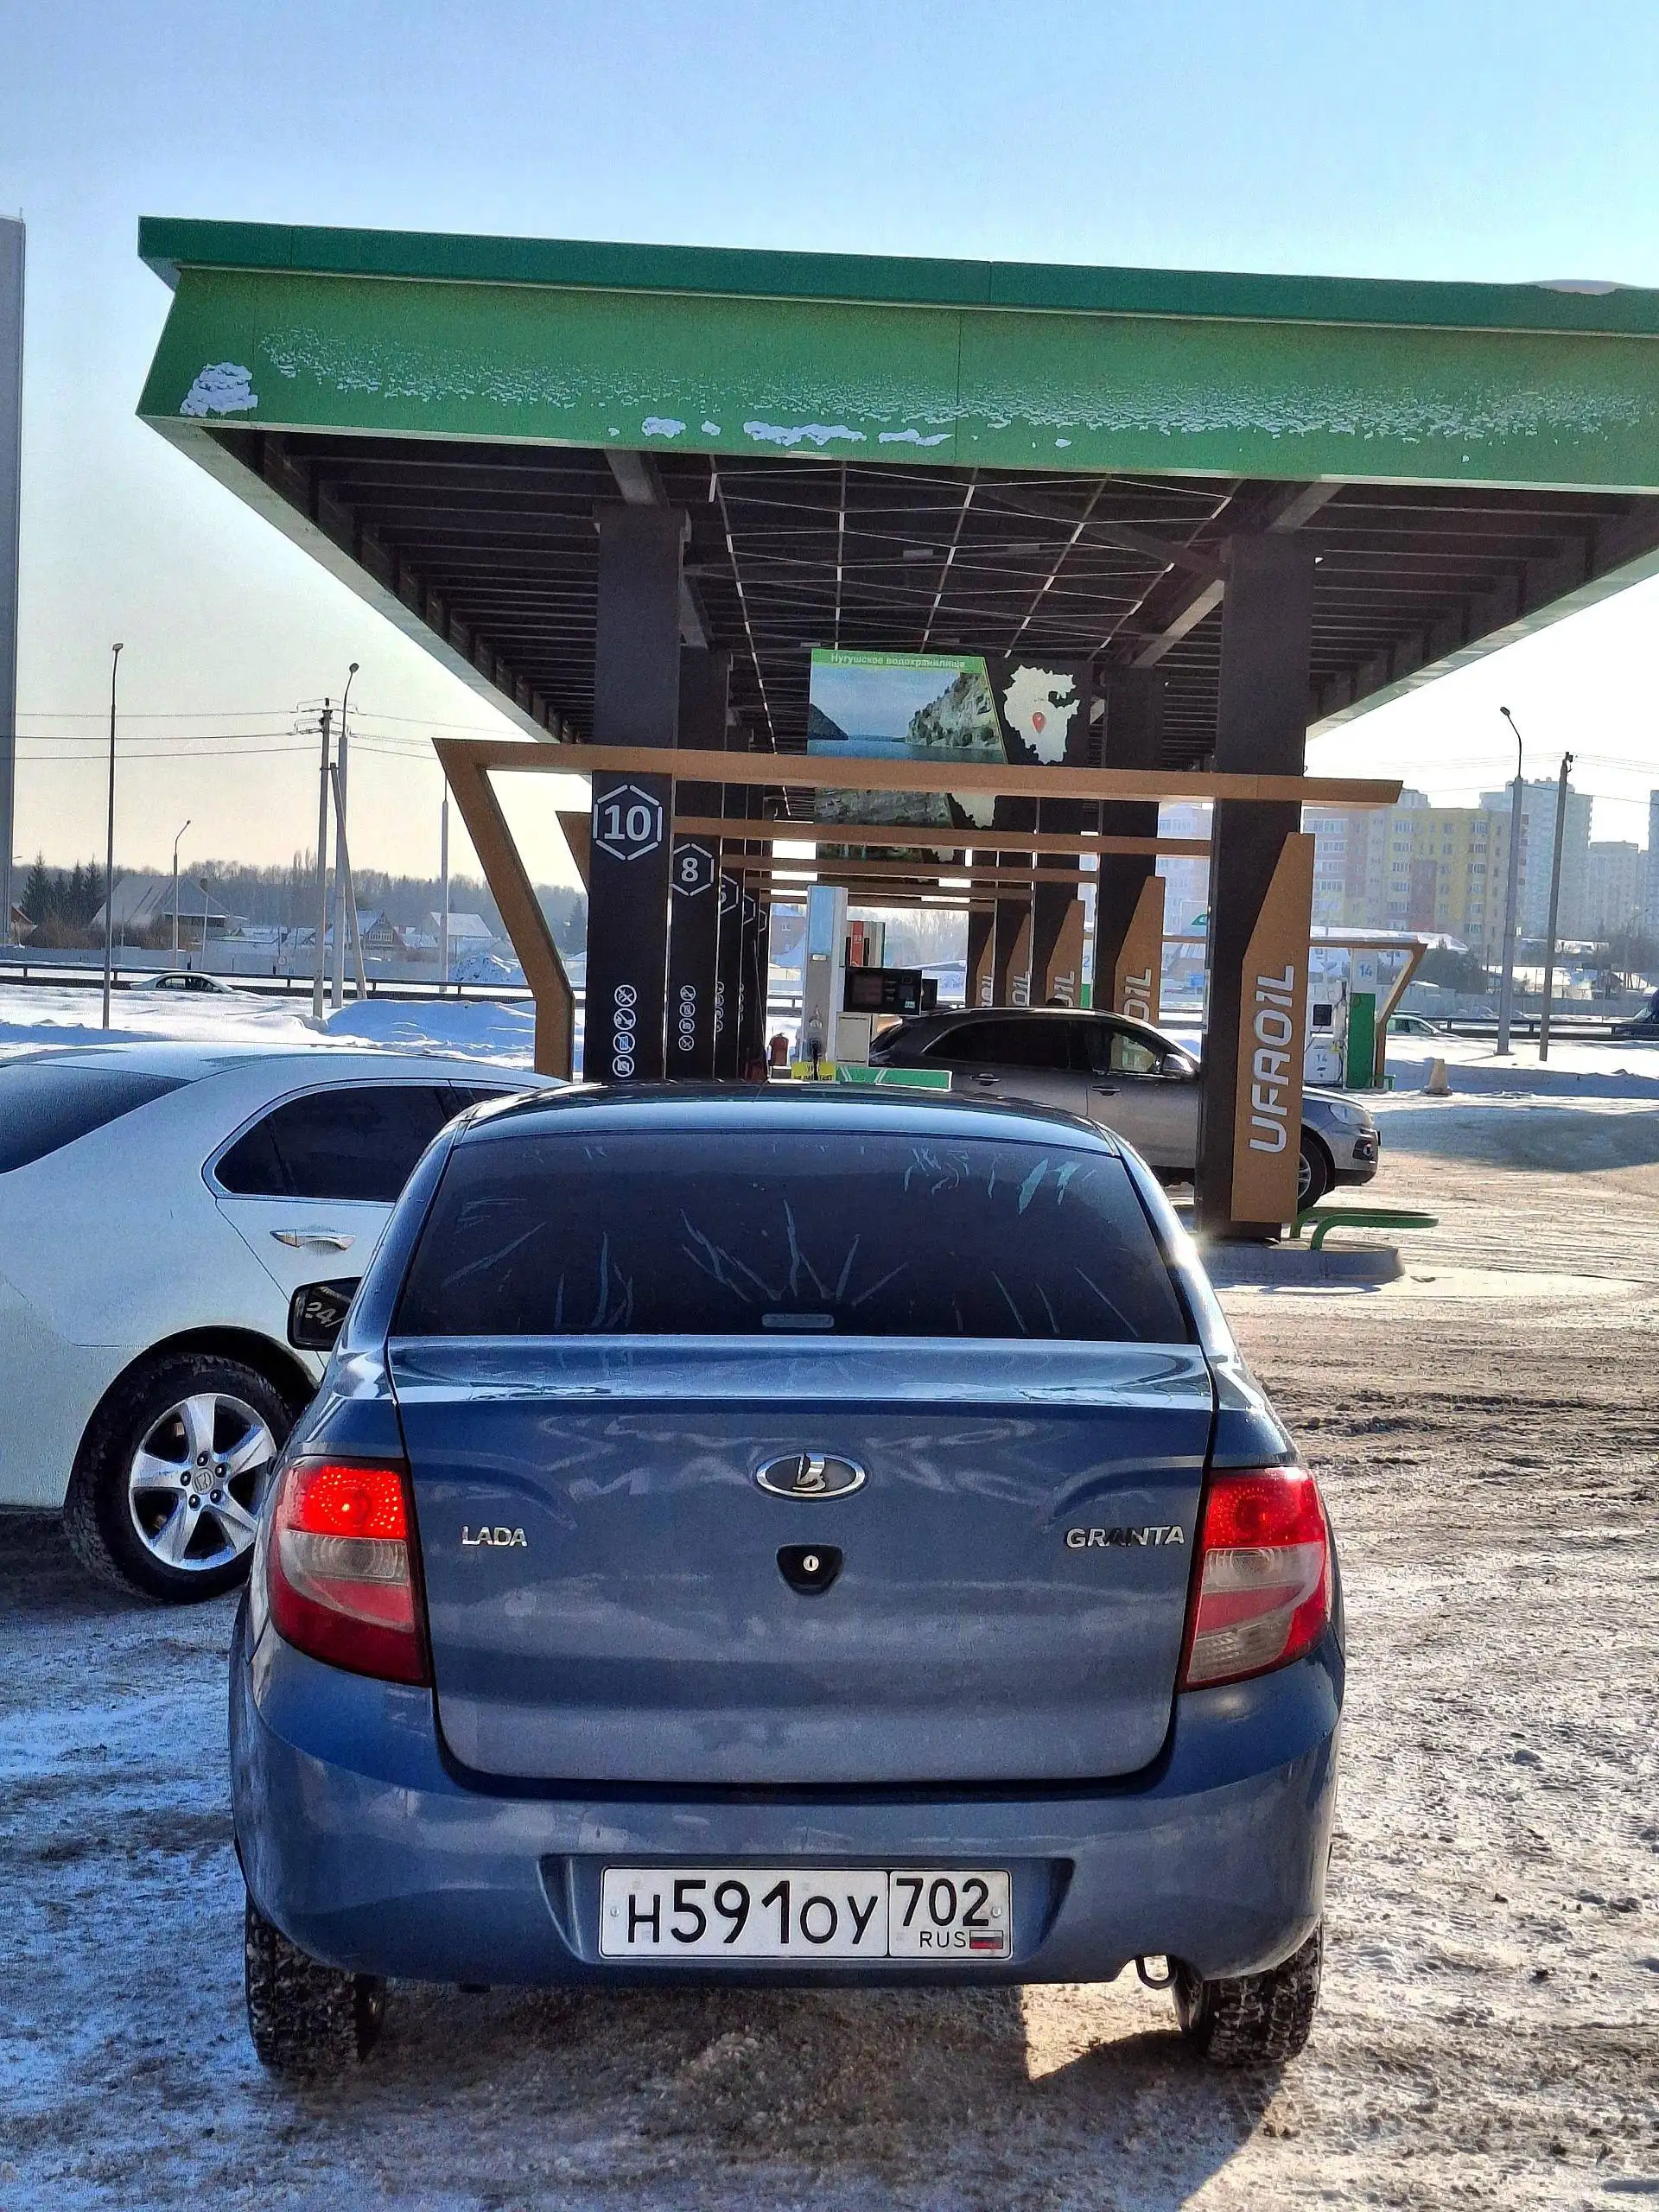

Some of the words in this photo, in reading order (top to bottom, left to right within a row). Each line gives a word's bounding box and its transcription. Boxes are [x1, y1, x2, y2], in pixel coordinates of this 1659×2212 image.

[830, 653, 883, 664] Нугушское
[886, 657, 965, 668] водохранилище
[604, 804, 652, 841] 10
[681, 857, 699, 882] 8
[1358, 964, 1372, 978] 14
[1249, 965, 1294, 1154] UFAOIL
[461, 1525, 528, 1547] LADA
[1066, 1526, 1185, 1549] GRANTA
[896, 1878, 989, 1927] 702
[919, 1930, 967, 1948] RUS
